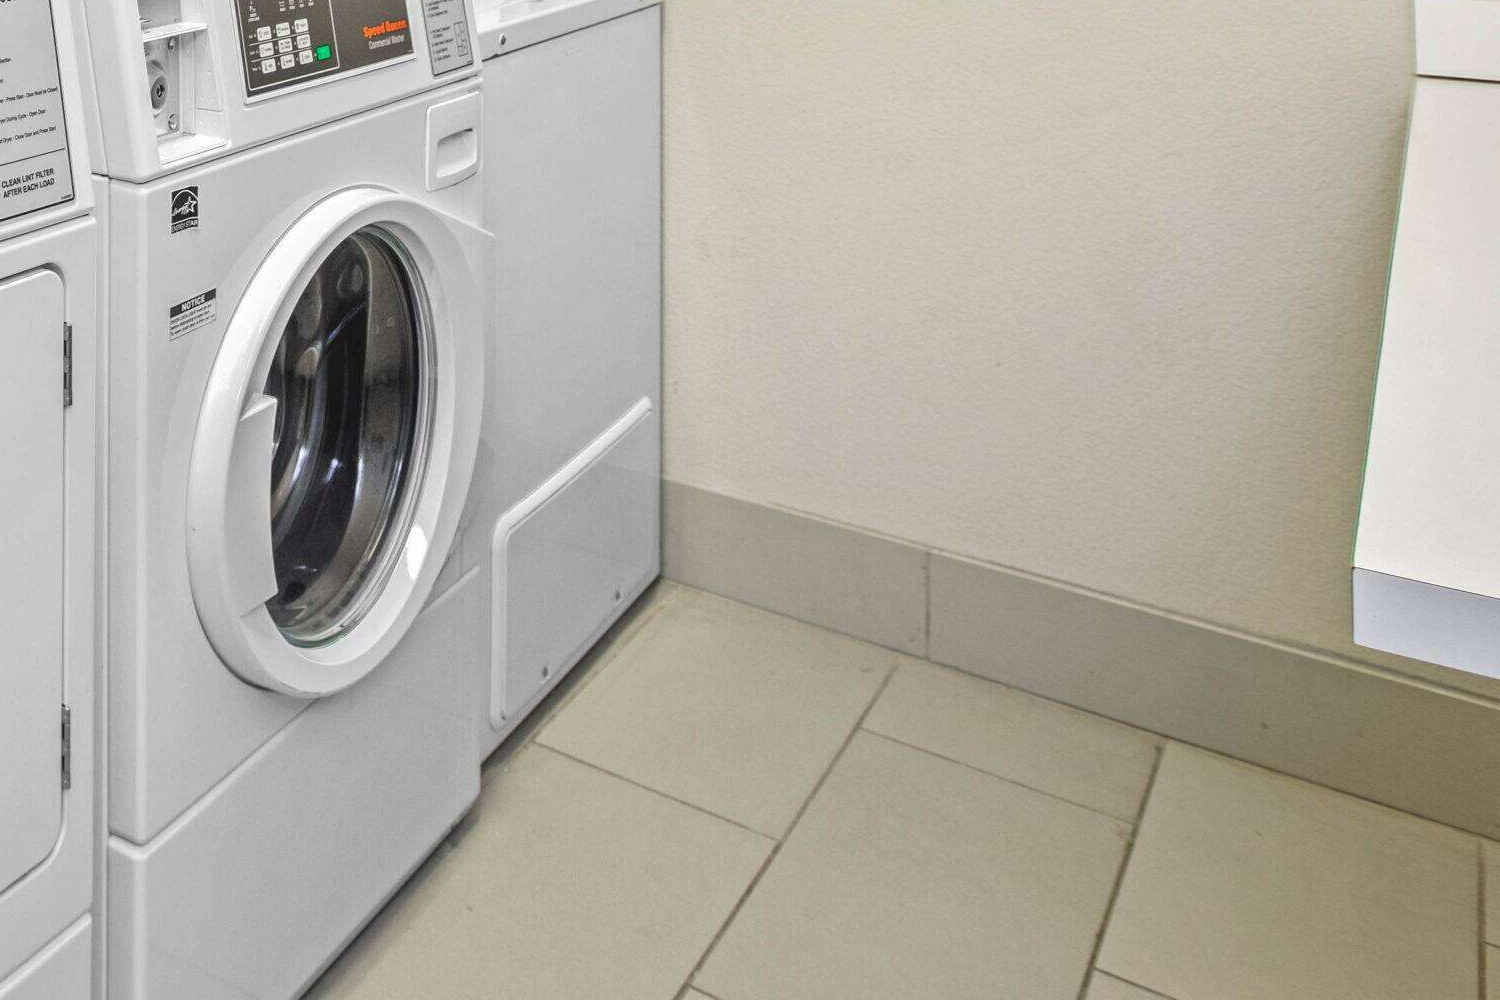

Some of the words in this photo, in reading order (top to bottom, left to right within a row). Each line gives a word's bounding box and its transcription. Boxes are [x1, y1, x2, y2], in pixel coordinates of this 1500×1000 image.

[363, 21, 385, 39] Speed
[1, 176, 21, 188] CLEAN
[21, 172, 34, 183] LINT
[35, 168, 54, 179] FILTER
[3, 187, 22, 199] AFTER
[23, 182, 38, 194] EACH
[39, 178, 55, 189] LOAD
[181, 294, 206, 312] NOTICE
